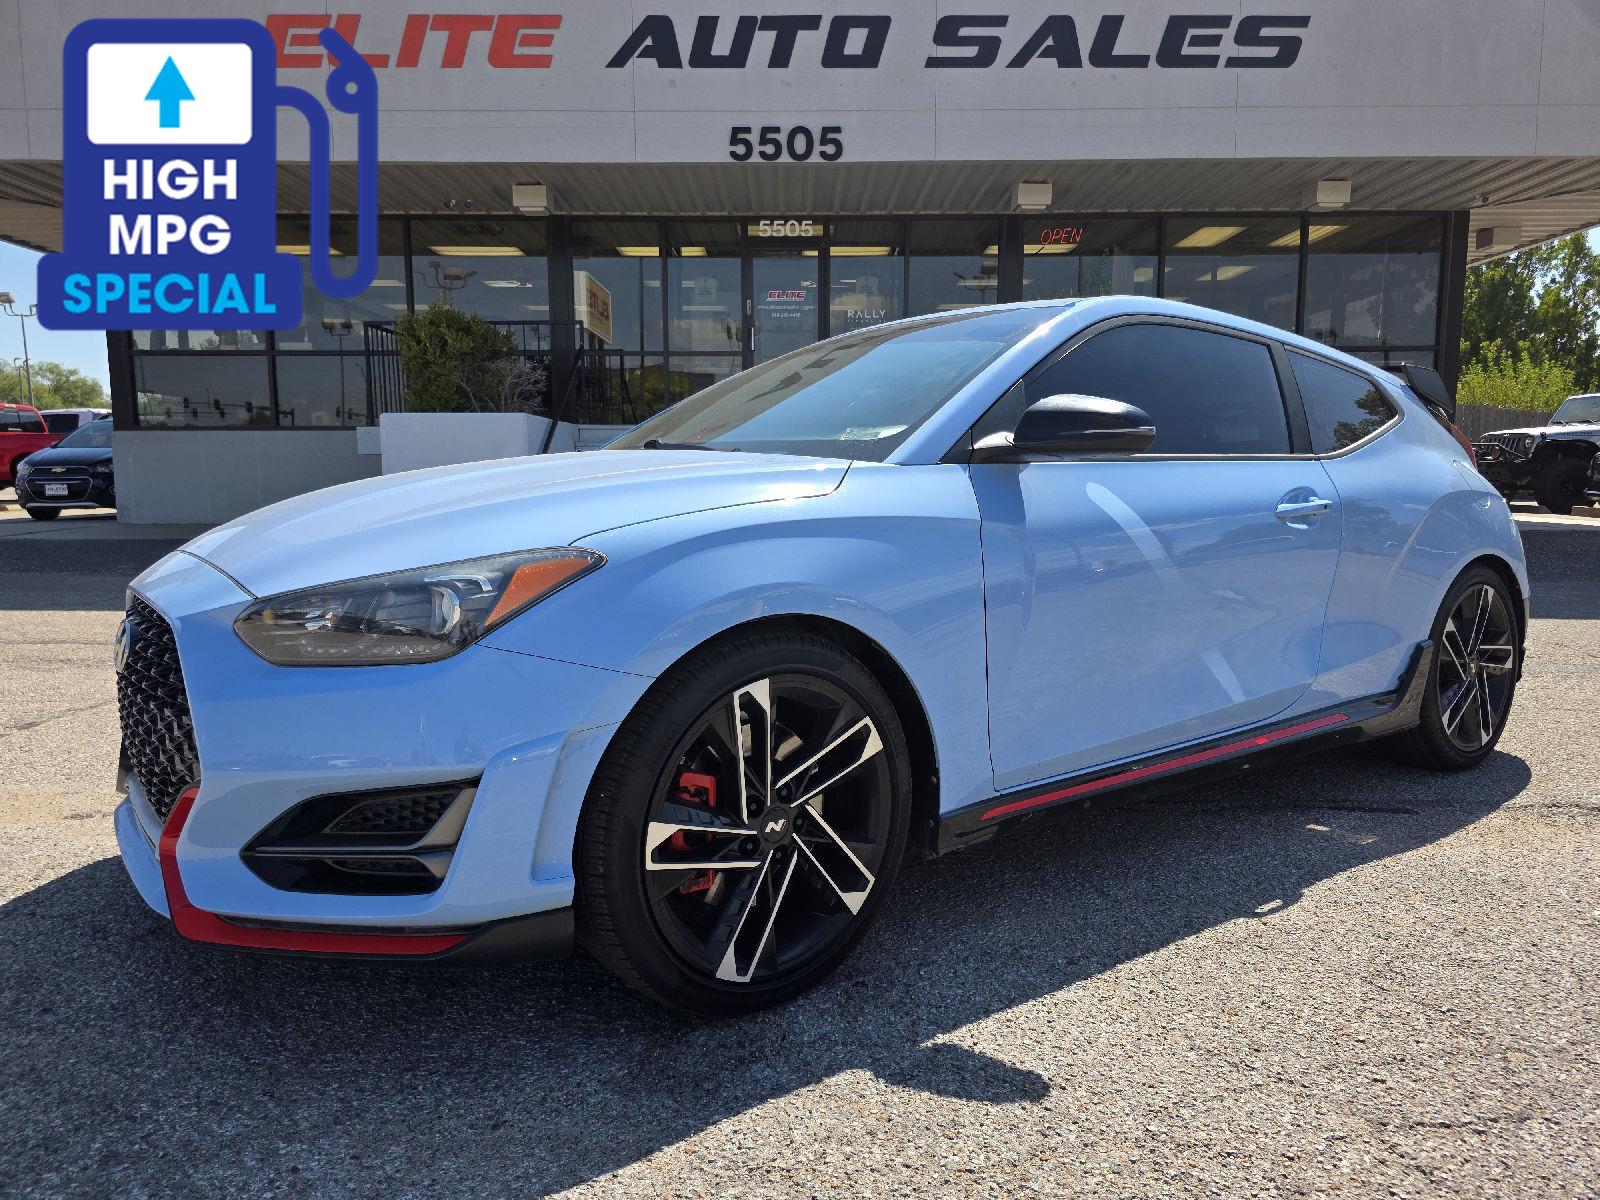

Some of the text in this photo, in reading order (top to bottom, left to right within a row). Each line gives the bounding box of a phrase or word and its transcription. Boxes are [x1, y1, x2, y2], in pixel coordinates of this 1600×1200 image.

[265, 14, 1311, 69] ELITE AUTO SALES
[729, 125, 844, 162] 5505
[758, 220, 814, 237] 5505
[1040, 227, 1083, 245] OPEN
[768, 290, 806, 299] ELITE
[847, 309, 886, 319] RALLY
